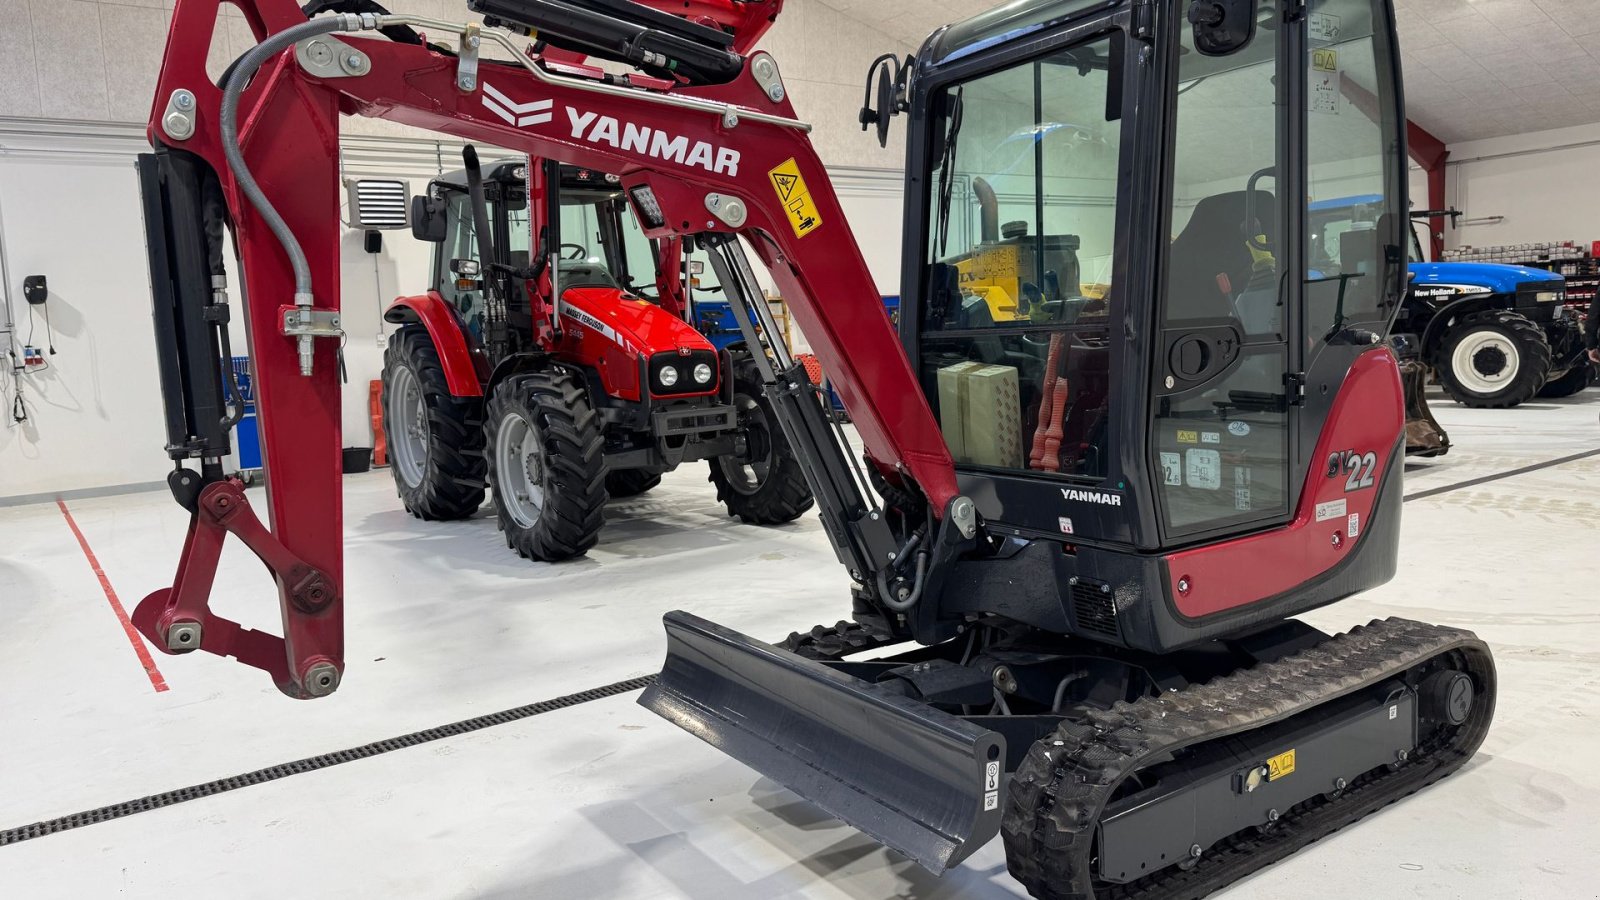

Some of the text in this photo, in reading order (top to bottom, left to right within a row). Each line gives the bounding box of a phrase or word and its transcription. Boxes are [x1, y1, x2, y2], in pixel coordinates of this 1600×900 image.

[565, 106, 741, 177] YANMAR
[1430, 288, 1456, 296] Holland
[581, 314, 605, 332] FERGUSON
[568, 329, 584, 339] 5445
[1060, 488, 1121, 506] YANMAR
